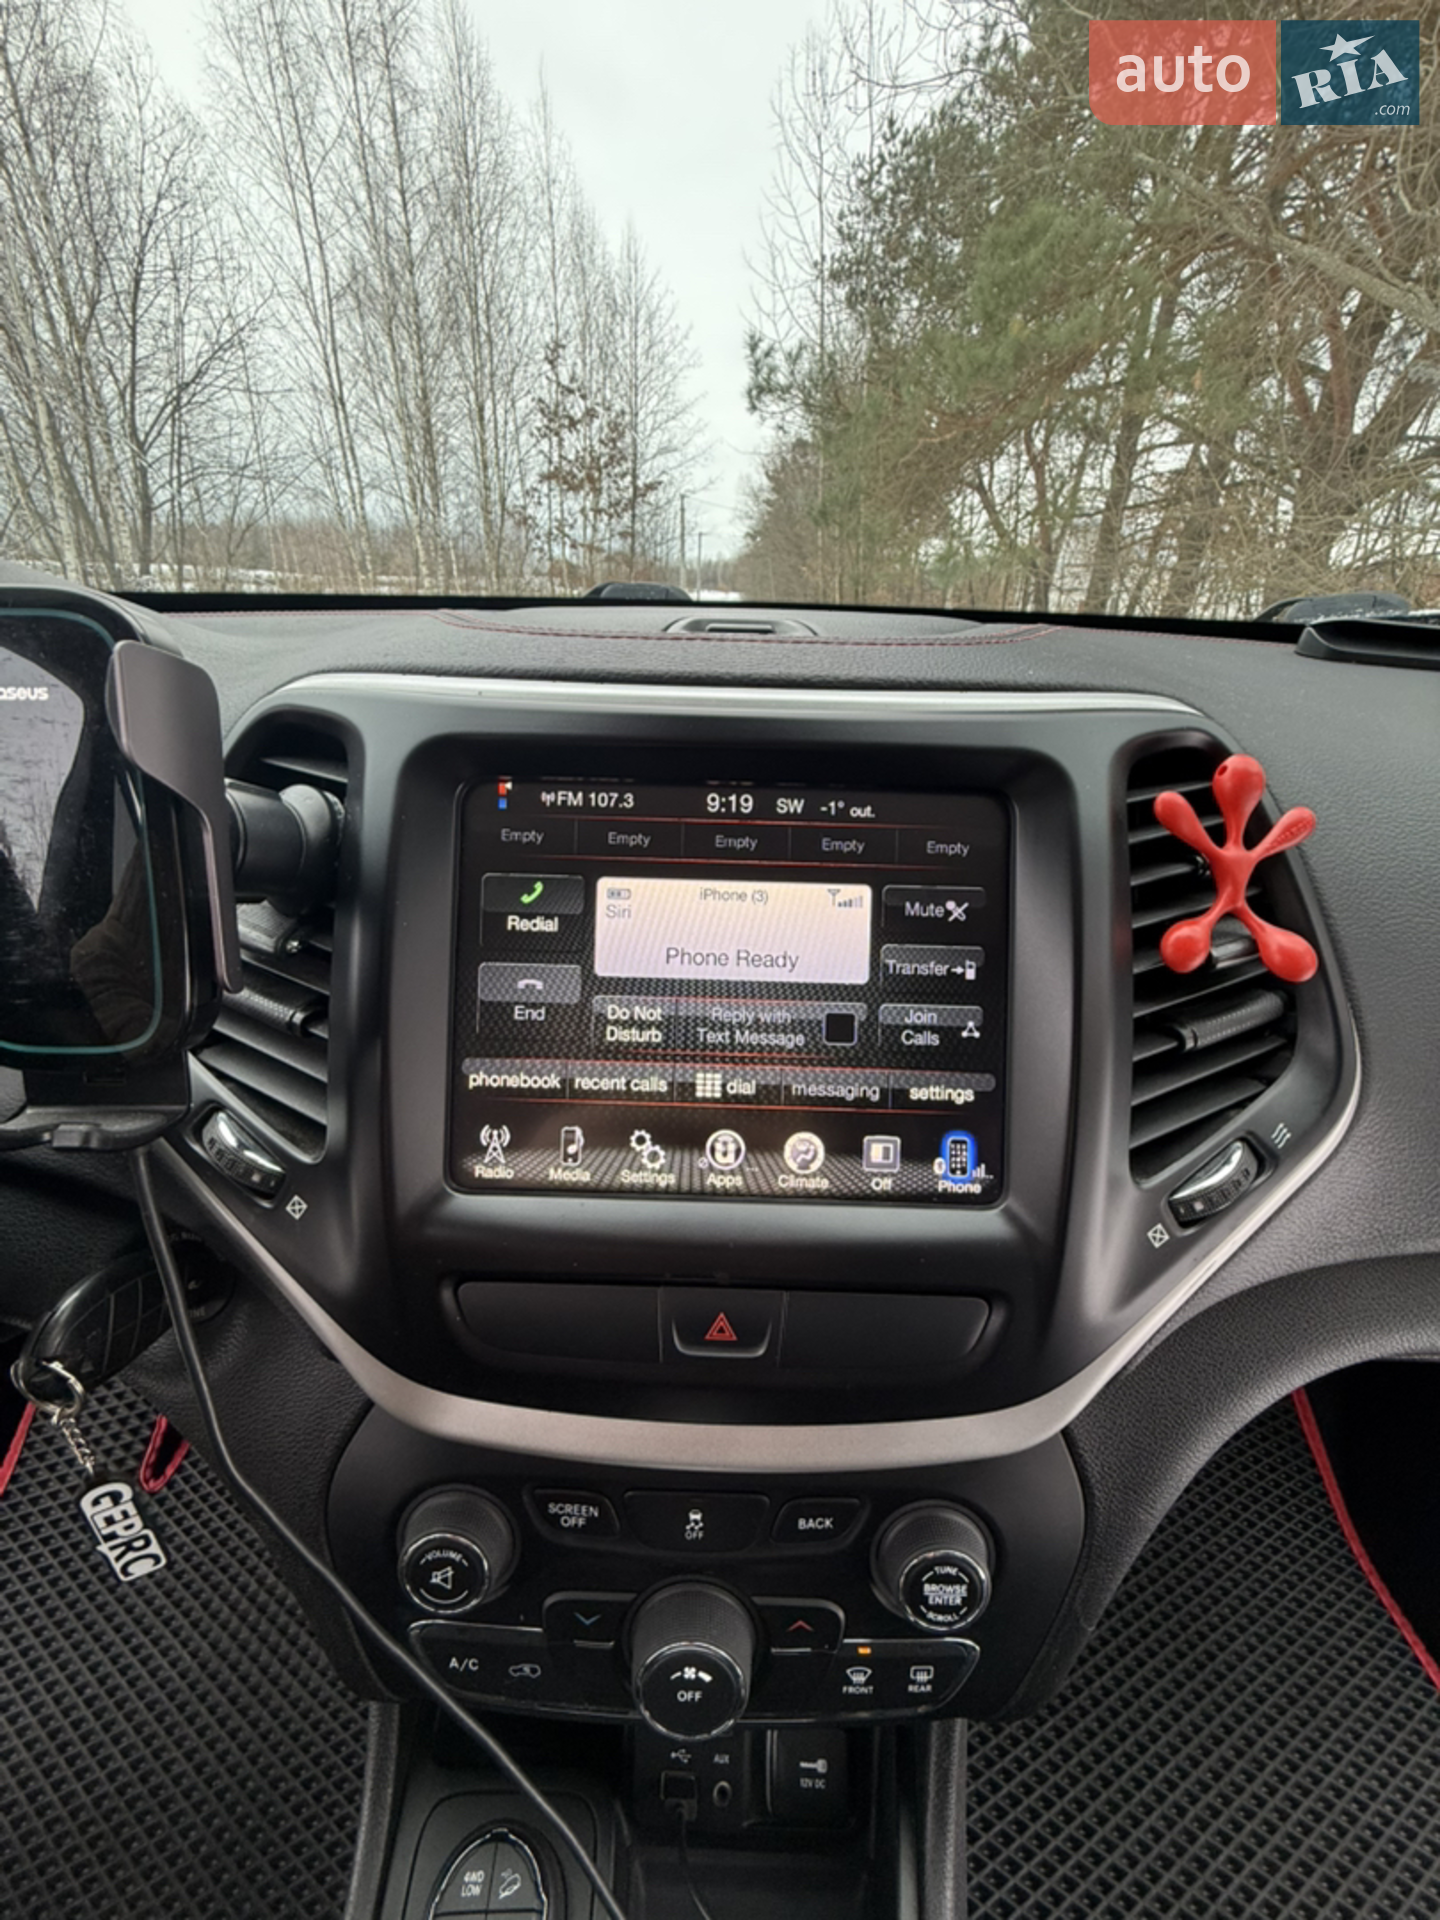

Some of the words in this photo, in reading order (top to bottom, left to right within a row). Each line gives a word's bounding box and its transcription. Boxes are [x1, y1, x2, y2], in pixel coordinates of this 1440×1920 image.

[557, 792, 584, 807] FM
[589, 792, 635, 809] 107.3
[706, 793, 754, 814] 9:19
[776, 798, 805, 814] SW
[850, 805, 876, 818] out.
[501, 828, 544, 844] Empty
[608, 831, 651, 847] Empty
[715, 835, 758, 850] Empty
[821, 838, 865, 854] Empty
[926, 841, 970, 857] Empty
[606, 904, 632, 919] Siri
[904, 901, 945, 918] Mute
[507, 915, 559, 932] Redial
[665, 946, 730, 967] Phone
[736, 948, 799, 971] Ready
[885, 959, 950, 977] Transfer
[514, 1005, 546, 1021] End
[606, 1005, 630, 1020] Do
[634, 1005, 662, 1021] Not
[712, 1006, 757, 1024] Reply
[760, 1007, 792, 1023] with
[904, 1008, 938, 1024] Join
[606, 1025, 662, 1043] Disturb
[699, 1028, 730, 1044] Text
[735, 1029, 805, 1048] Message
[901, 1029, 940, 1046] Calls
[468, 1071, 561, 1090] phonebook
[575, 1076, 627, 1092] recent
[630, 1076, 668, 1092] calls
[726, 1079, 757, 1096] dial
[792, 1083, 881, 1102] messaging
[909, 1084, 975, 1105] settings
[474, 1165, 515, 1179] Radio
[550, 1168, 591, 1182] Media
[620, 1170, 676, 1187] Settings
[706, 1172, 744, 1188] Apps
[778, 1175, 829, 1190] Climate
[871, 1177, 893, 1192] Off
[938, 1180, 983, 1195] Phone
[548, 1502, 599, 1517] SCREEN
[560, 1516, 587, 1528] OFF
[797, 1517, 834, 1530] BACK
[80, 1482, 167, 1581] GEPRC
[685, 1530, 705, 1541] OFF
[425, 1549, 463, 1563] VOLUME
[934, 1565, 959, 1576] TUNE
[923, 1583, 968, 1595] BROWSE
[928, 1595, 963, 1606] ENTER
[449, 1656, 479, 1671] A/C
[676, 1689, 703, 1702] OFF
[842, 1684, 874, 1695] FRONT
[908, 1683, 932, 1694] REAR
